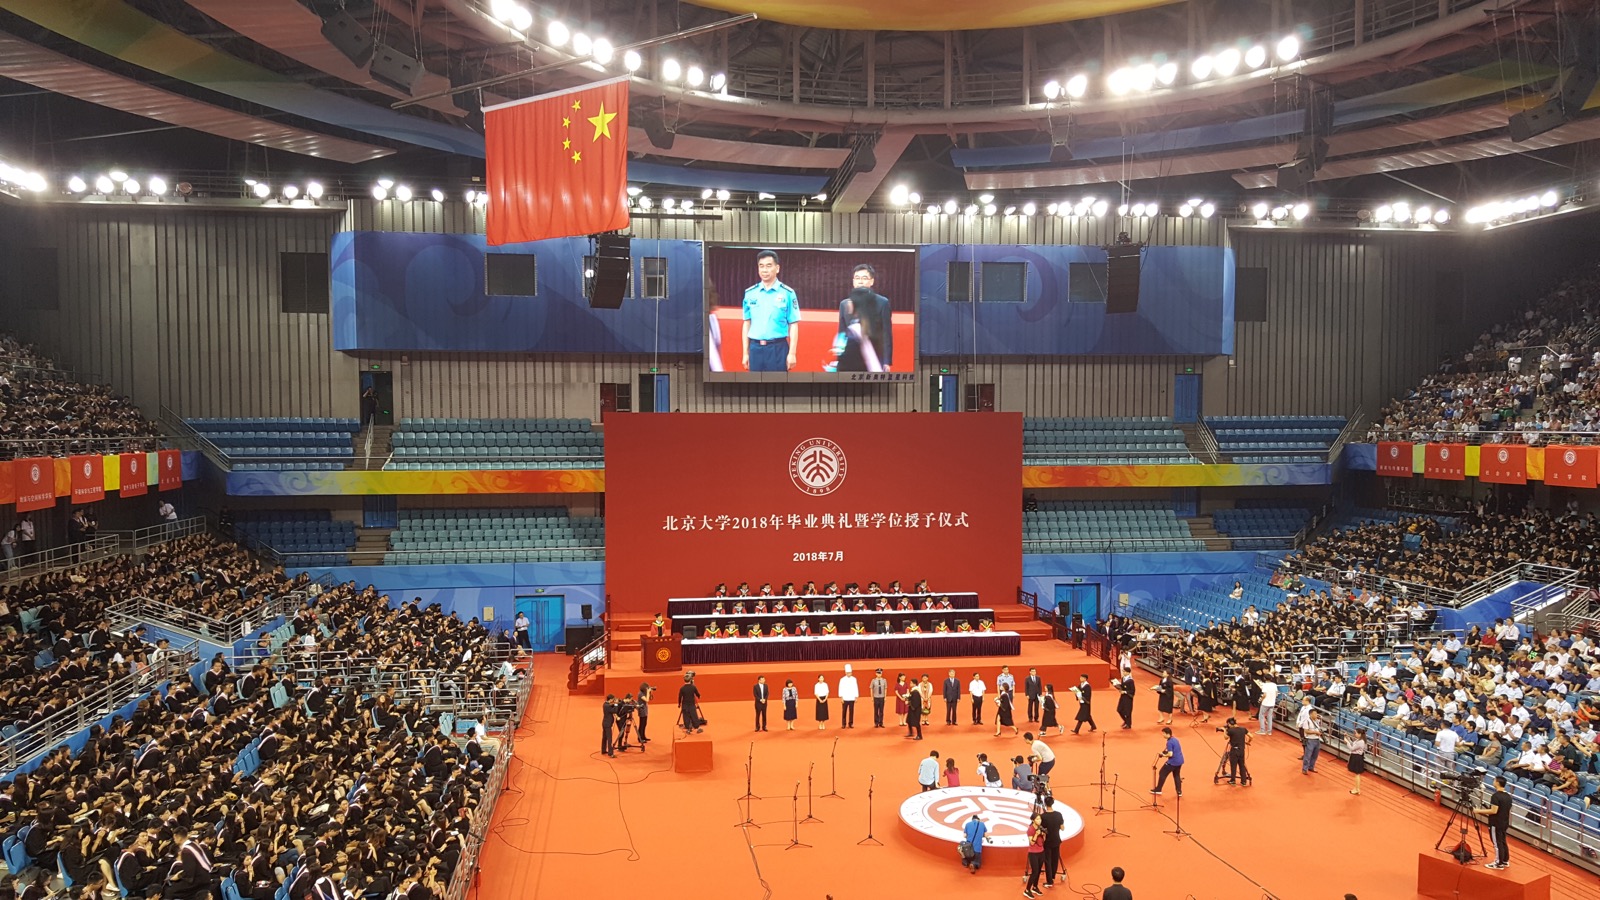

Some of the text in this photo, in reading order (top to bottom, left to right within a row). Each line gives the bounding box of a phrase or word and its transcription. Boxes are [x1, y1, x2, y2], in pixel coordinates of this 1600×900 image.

[791, 440, 845, 479] PEKING UNIVERSITY
[806, 486, 831, 494] 1898
[662, 512, 969, 532] 北京大学2018年毕业典礼暨学位授予仪式
[793, 550, 844, 562] 2018年7月
